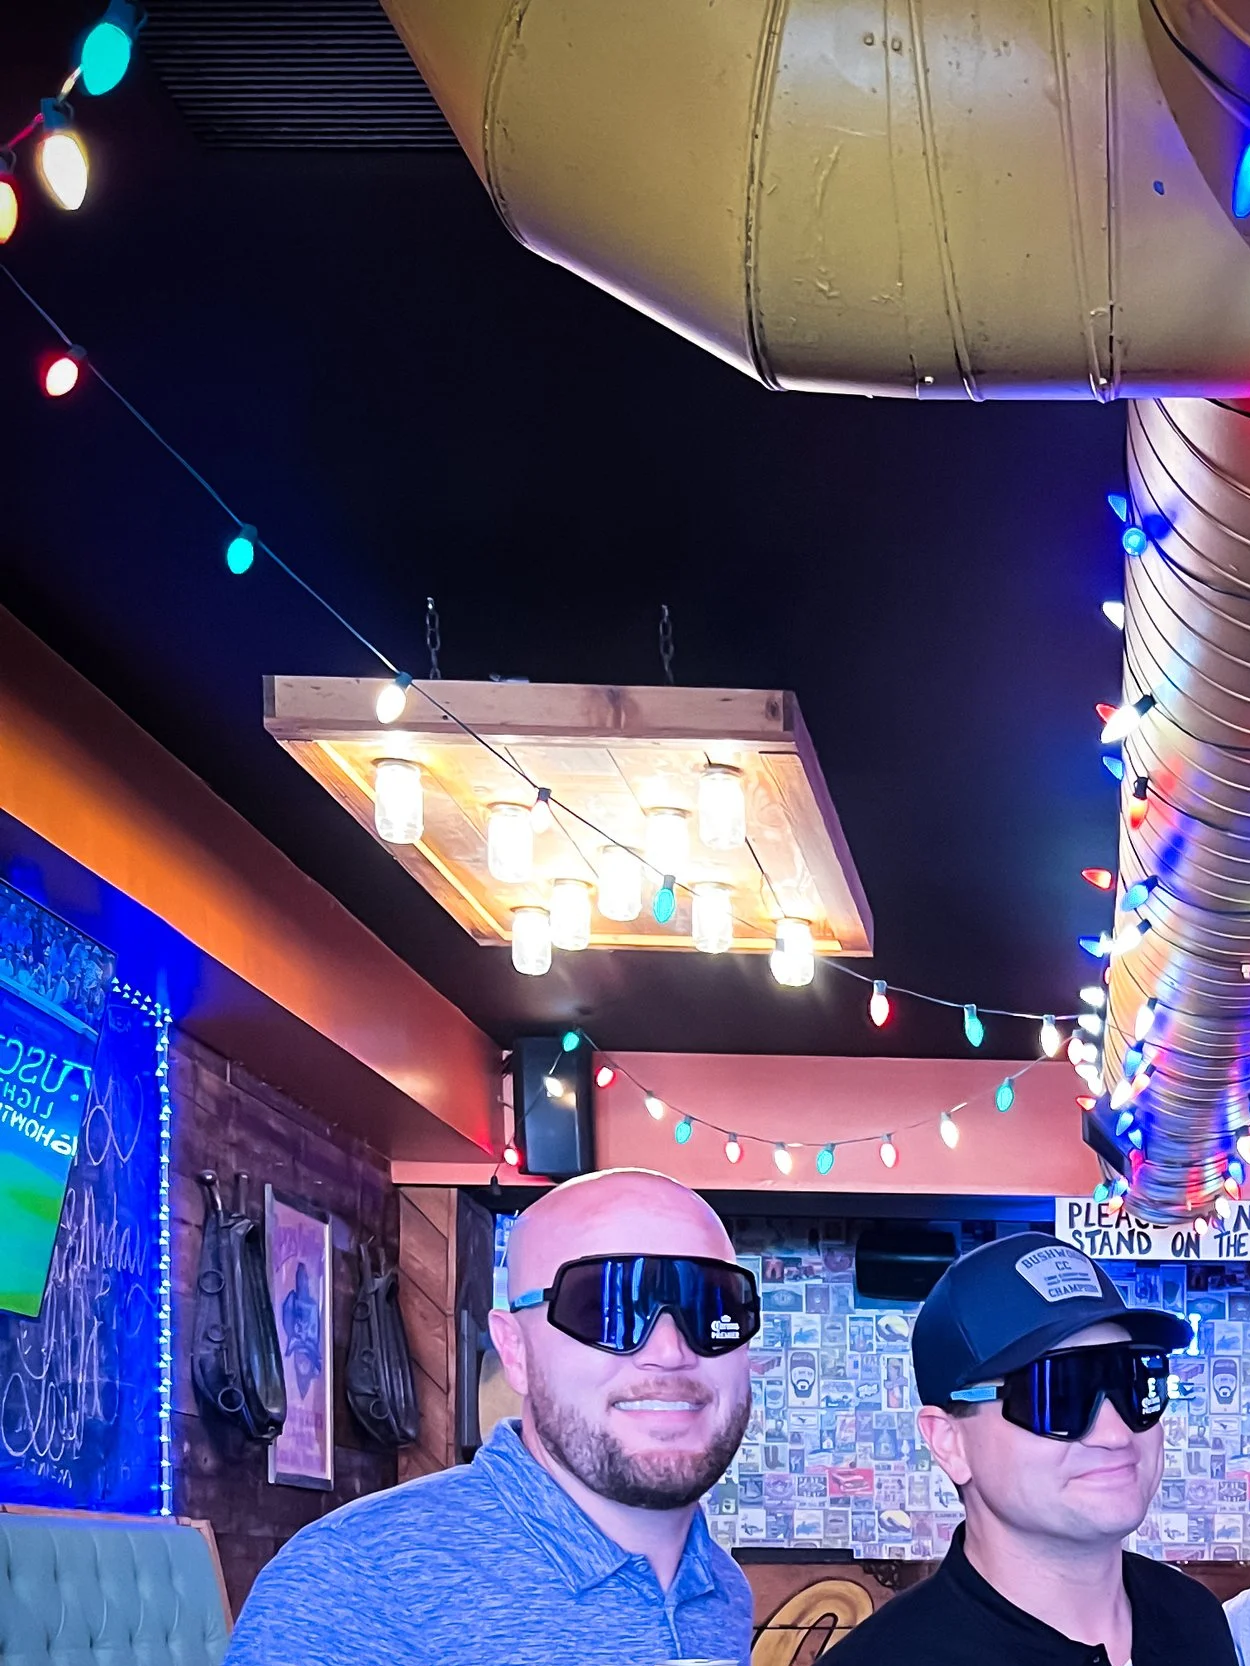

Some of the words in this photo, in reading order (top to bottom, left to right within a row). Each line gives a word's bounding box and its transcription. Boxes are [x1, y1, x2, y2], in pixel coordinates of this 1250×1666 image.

[1068, 1202, 1169, 1229] PLEA
[1072, 1229, 1152, 1256] STAND
[1171, 1231, 1200, 1258] ON
[1214, 1231, 1249, 1257] THE
